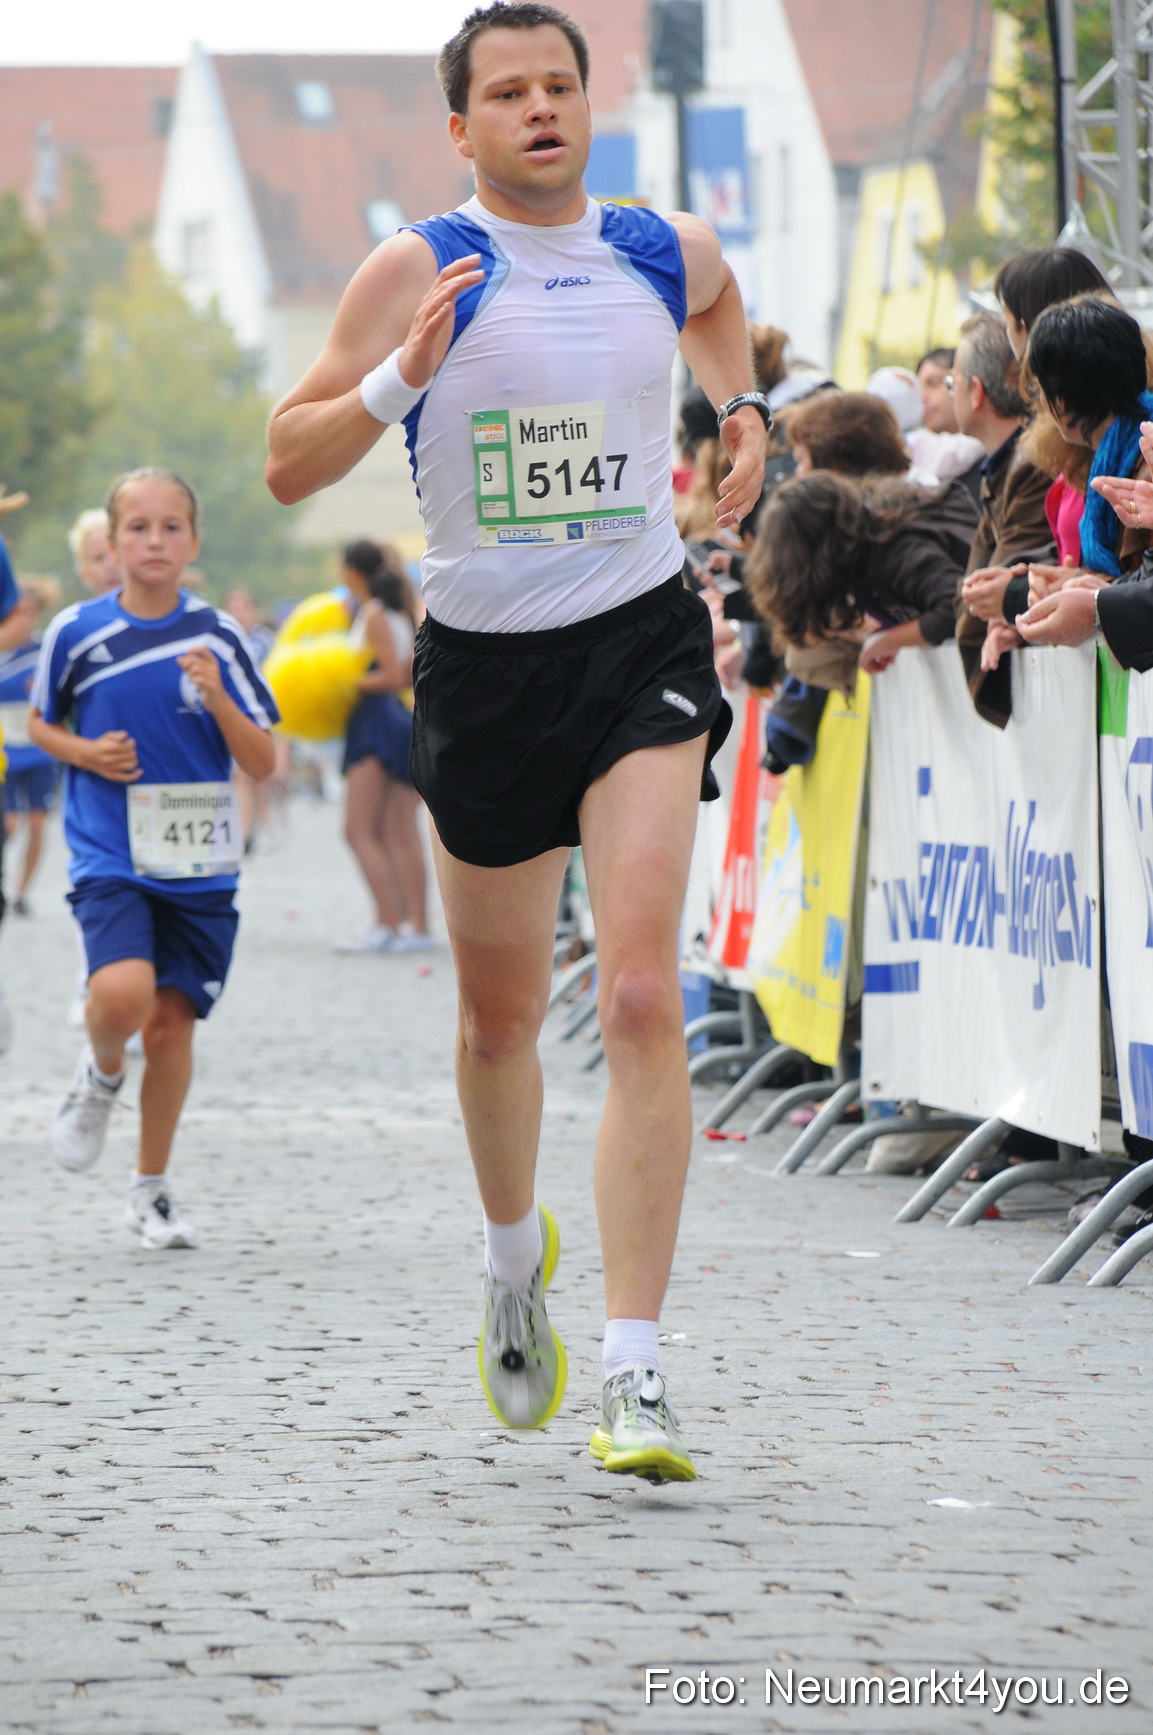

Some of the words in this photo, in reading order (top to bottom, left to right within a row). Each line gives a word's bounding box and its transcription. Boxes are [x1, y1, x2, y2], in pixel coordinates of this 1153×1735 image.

[560, 275, 591, 287] asics
[519, 417, 588, 444] Martin
[483, 463, 492, 482] S
[527, 453, 628, 499] 5147
[585, 515, 647, 532] PFLEIDERER
[498, 528, 542, 539] BOCK
[163, 820, 231, 846] 4121
